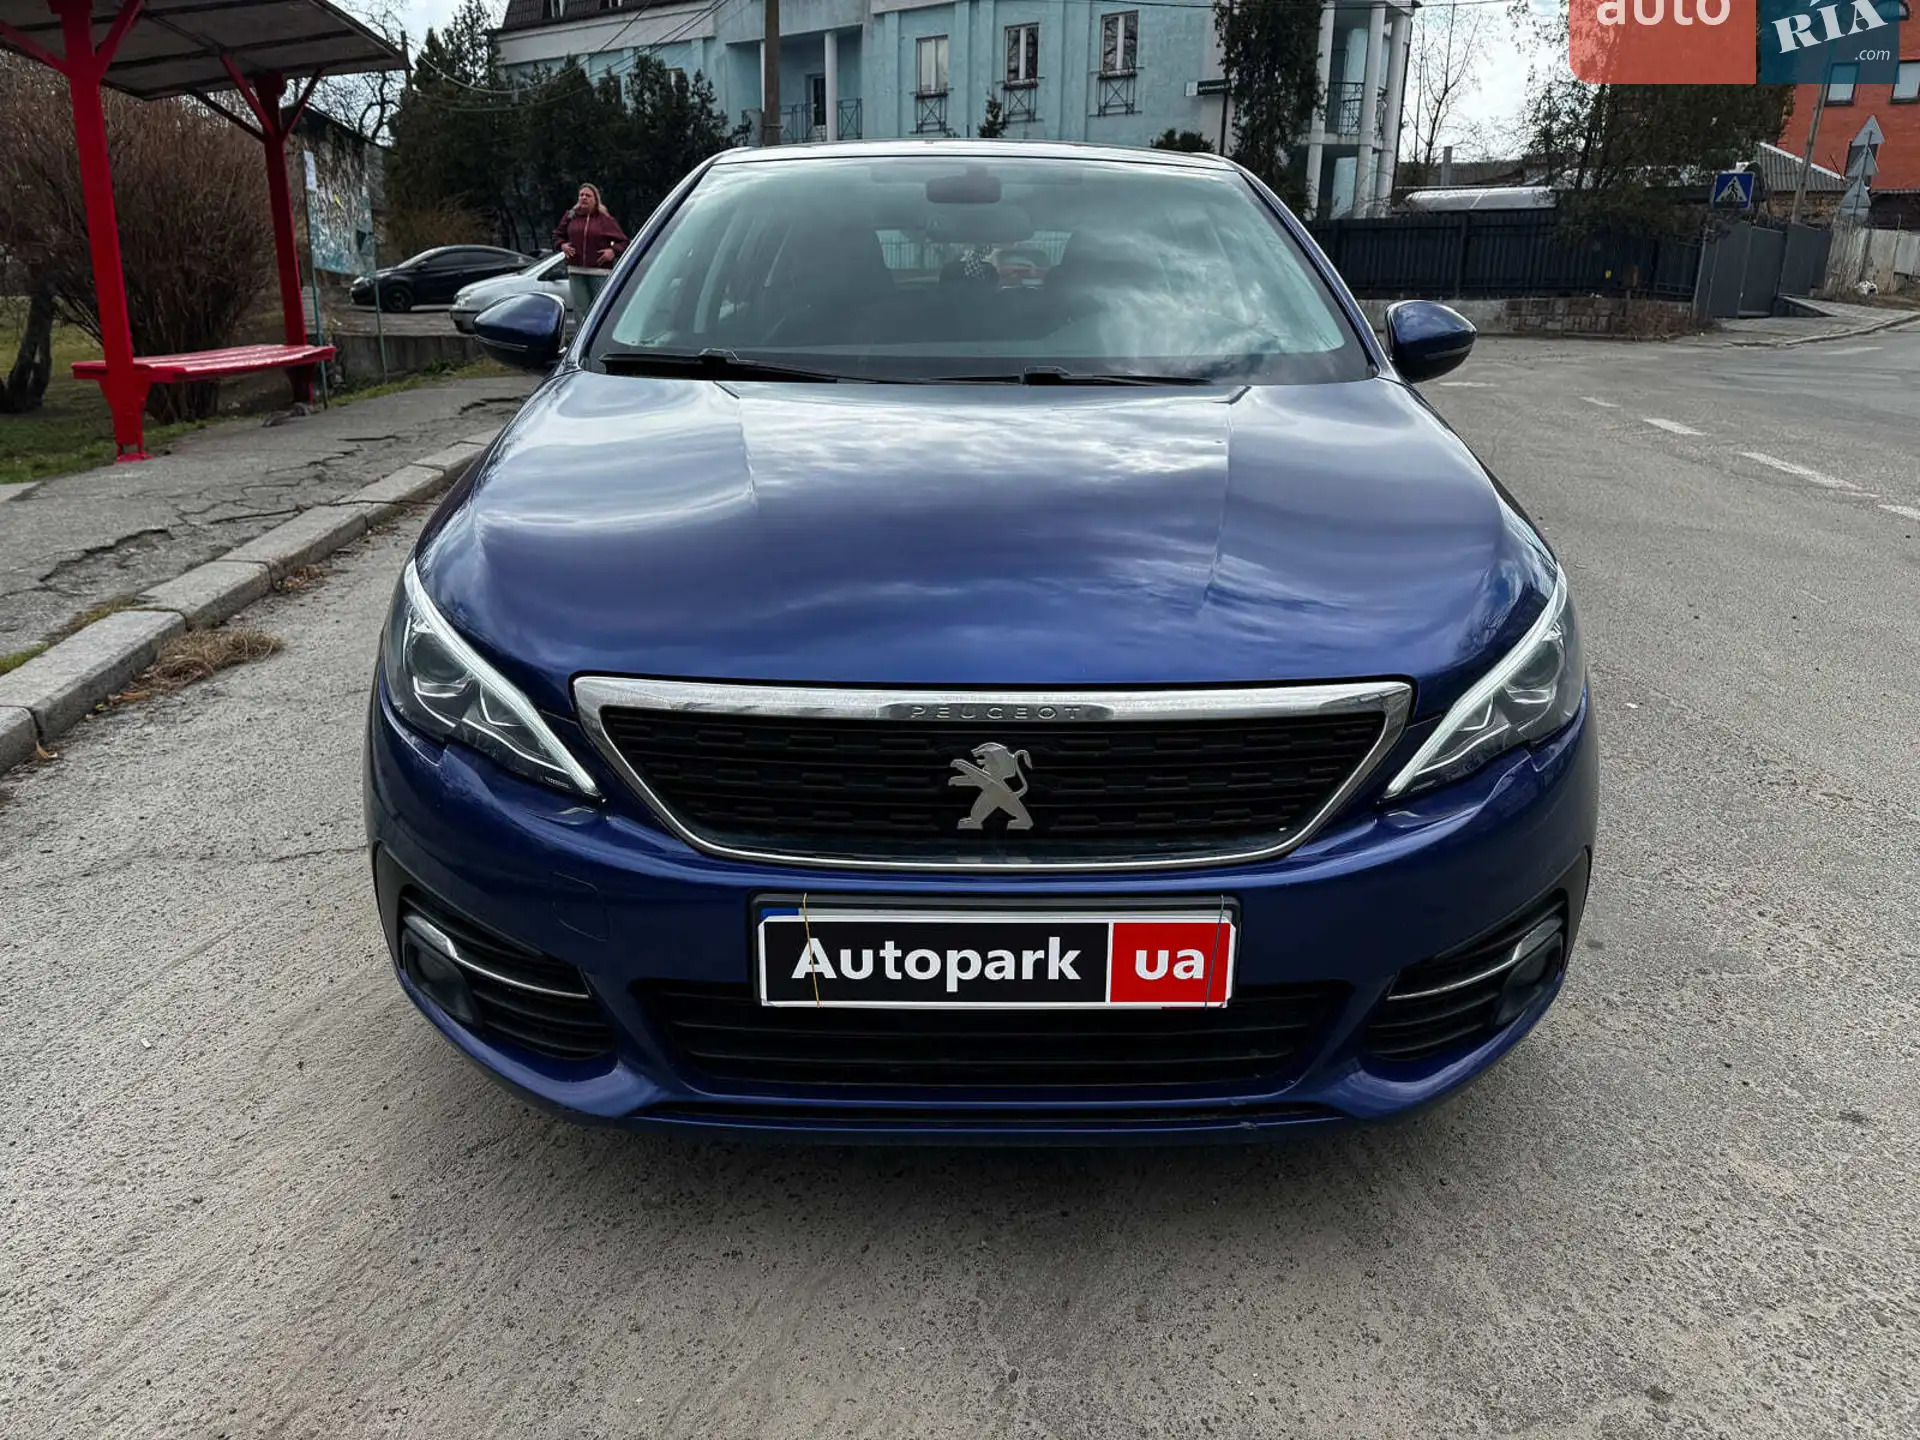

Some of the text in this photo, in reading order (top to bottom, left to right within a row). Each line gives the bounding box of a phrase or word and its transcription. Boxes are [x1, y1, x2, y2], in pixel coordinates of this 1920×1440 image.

[911, 706, 1081, 720] PEUGEOT
[791, 936, 1205, 992] Autopark ua
